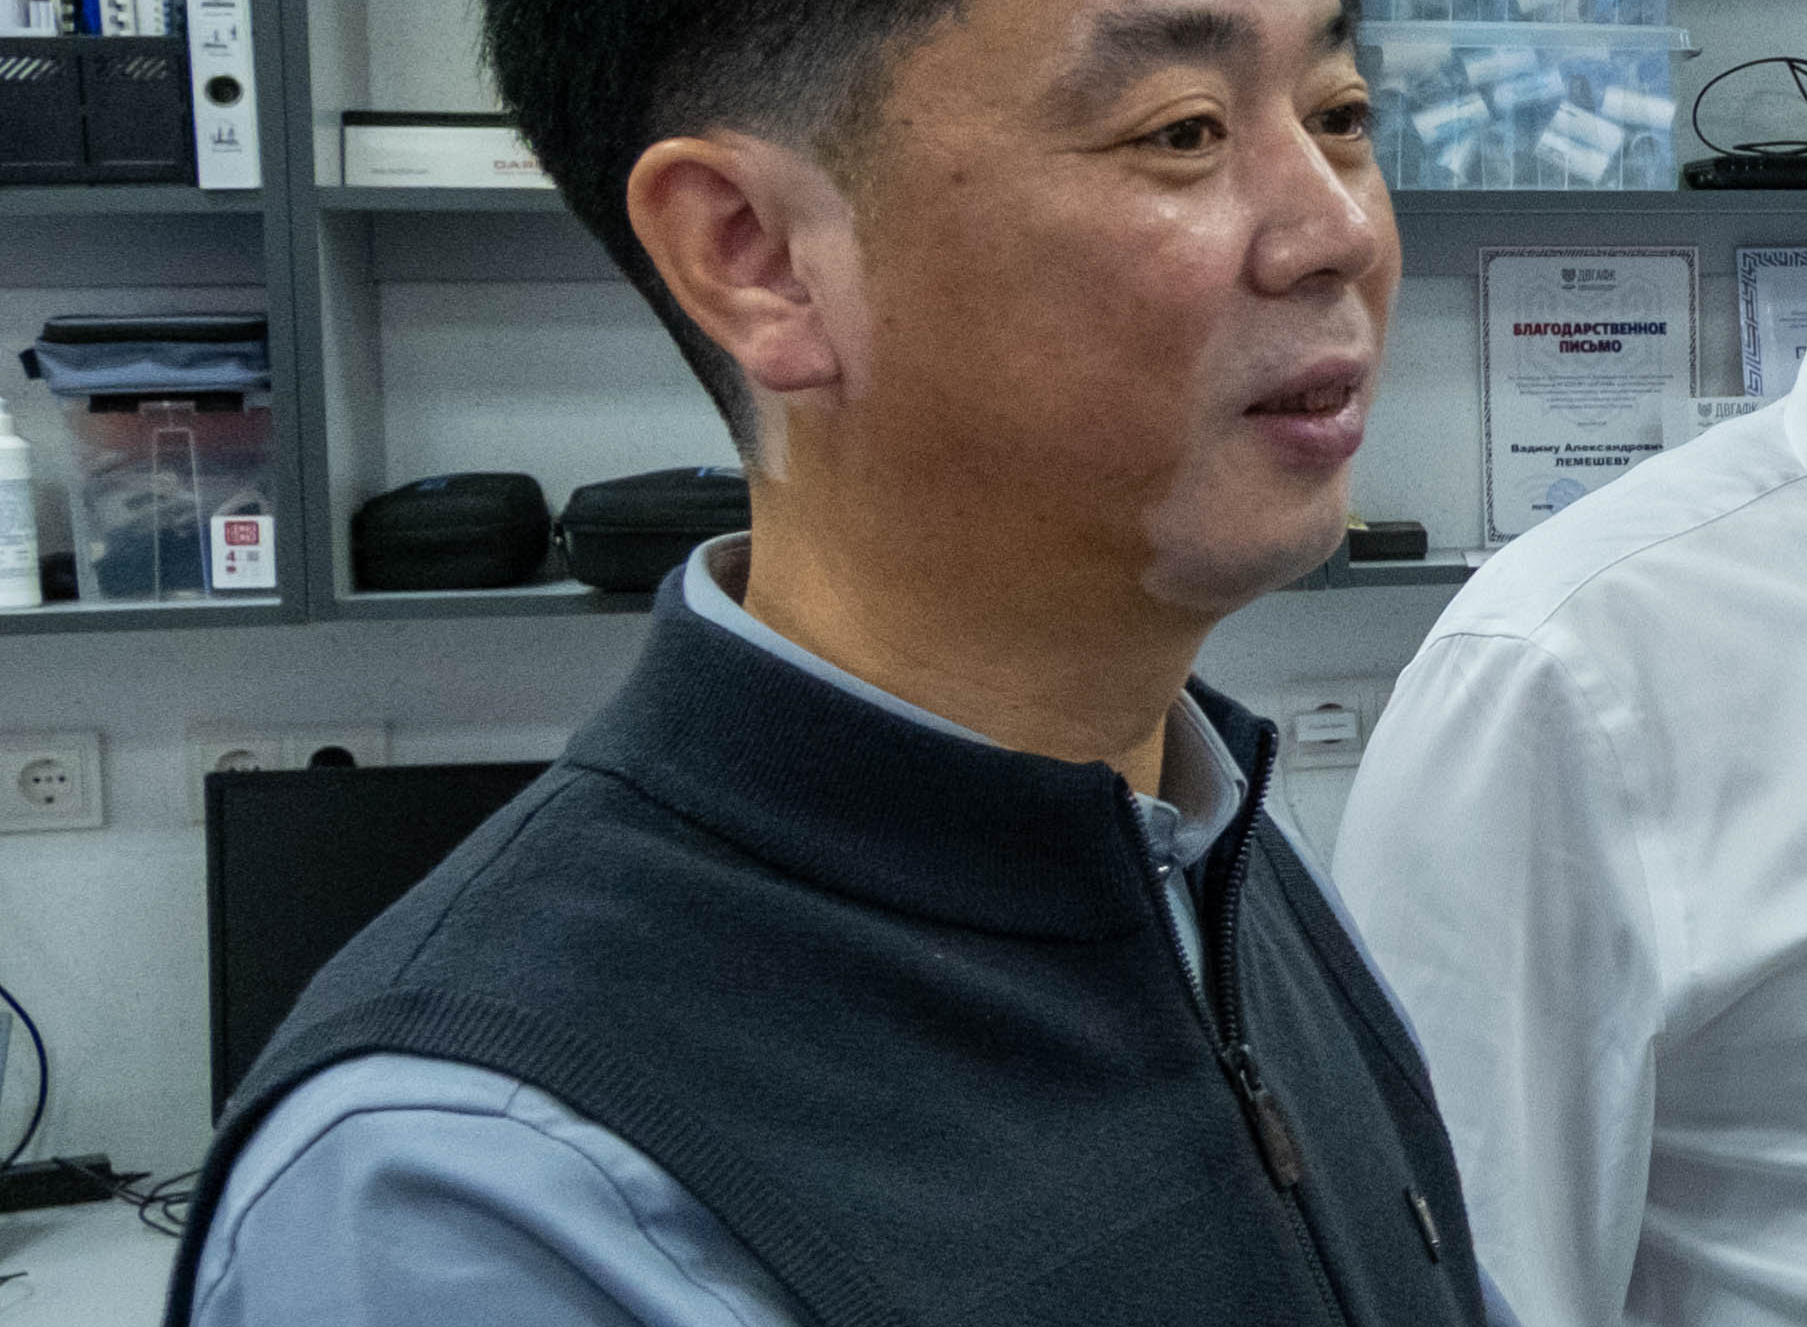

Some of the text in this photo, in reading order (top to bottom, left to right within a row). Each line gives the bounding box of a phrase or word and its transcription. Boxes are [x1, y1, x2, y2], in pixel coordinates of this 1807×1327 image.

[1513, 322, 1667, 338] БЛАГОДАРСТВЕННОЕ
[1559, 340, 1622, 353] ПИСЬМО
[1511, 444, 1560, 453] Вадиму
[1555, 457, 1630, 467] ЛЕМЕШЕВУ
